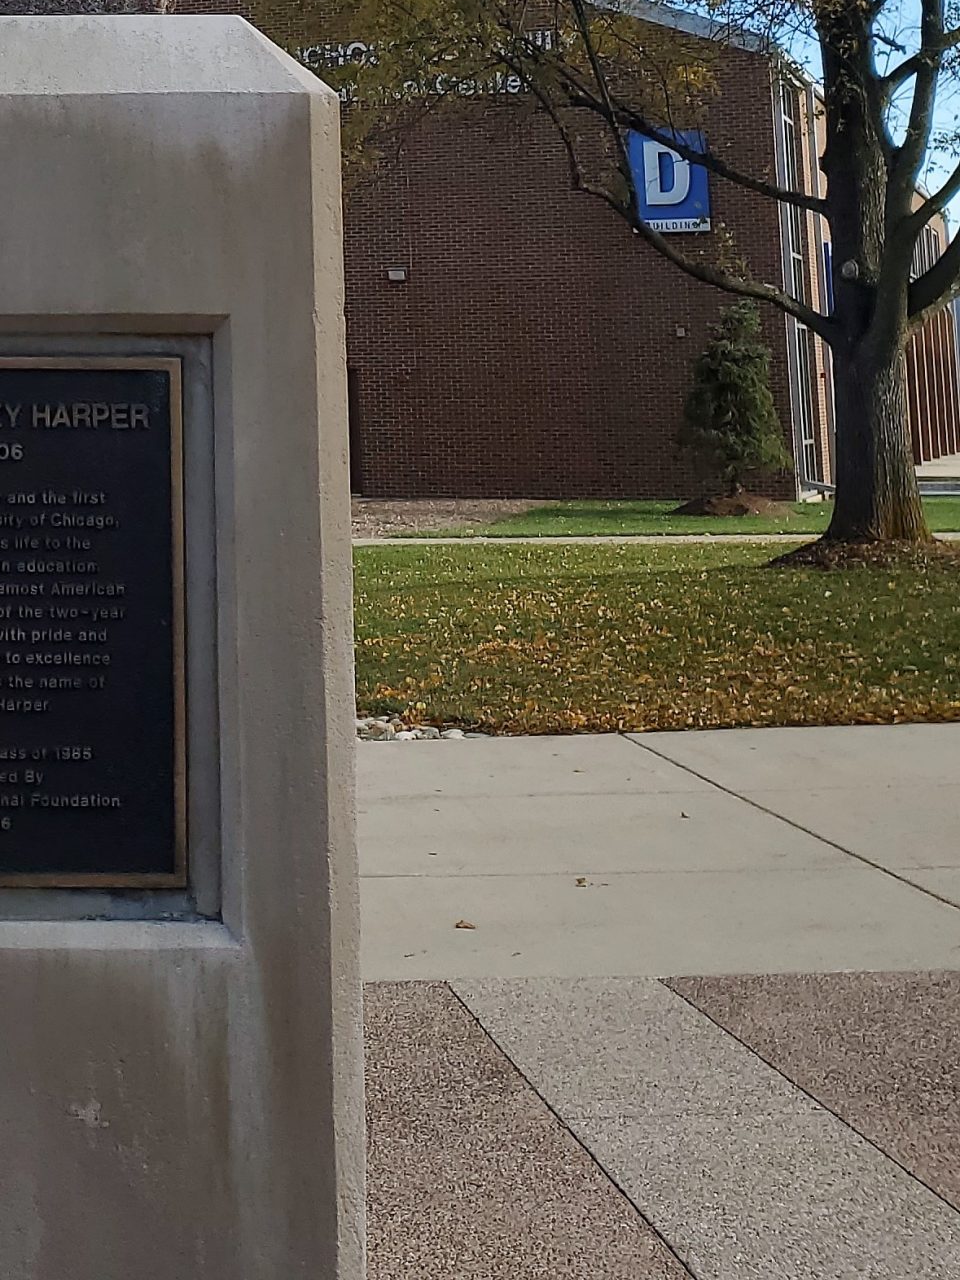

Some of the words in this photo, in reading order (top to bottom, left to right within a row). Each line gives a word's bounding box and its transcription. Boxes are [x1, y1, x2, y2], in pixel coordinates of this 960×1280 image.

[643, 139, 690, 205] D
[32, 402, 150, 429] HARPER
[7, 490, 35, 504] and
[42, 490, 66, 504] the
[73, 490, 107, 504] first
[30, 513, 46, 527] of
[14, 536, 39, 549] life
[45, 536, 61, 549] to
[66, 536, 91, 549] the
[51, 582, 125, 595] American
[18, 605, 43, 618] the
[32, 628, 72, 643] pride
[79, 628, 107, 641] and
[6, 651, 20, 664] to
[26, 651, 110, 664] excellence
[8, 675, 33, 688] the
[39, 675, 80, 688] name
[89, 675, 105, 688] of
[33, 745, 48, 760] of
[25, 769, 44, 785] By
[31, 794, 121, 807] Foundation
